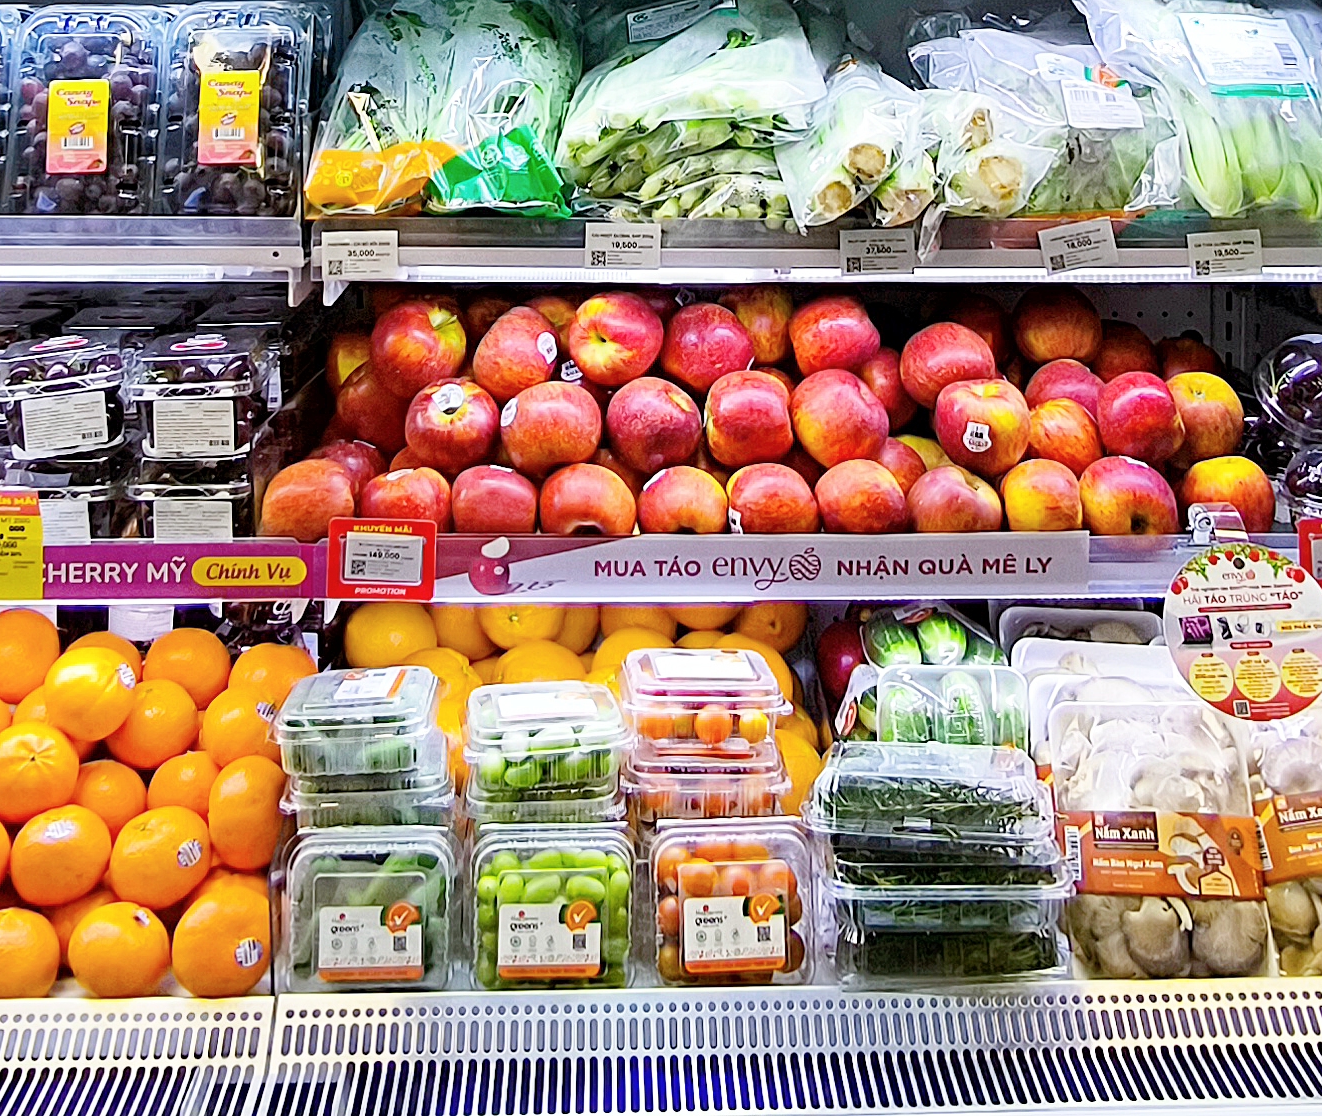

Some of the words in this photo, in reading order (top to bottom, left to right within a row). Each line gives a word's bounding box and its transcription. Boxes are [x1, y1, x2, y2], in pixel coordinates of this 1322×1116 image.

[207, 78, 246, 90] Candy
[56, 88, 95, 100] Candy
[353, 525, 392, 534] KHUYẾN
[393, 525, 413, 535] MÃI
[368, 550, 400, 561] 149,000
[43, 562, 140, 584] HERRY
[145, 555, 187, 584] MỸ
[205, 563, 262, 582] Chính
[264, 563, 292, 584] Vụ
[594, 559, 646, 577] MUA
[653, 554, 702, 577] TÁO
[711, 555, 787, 591] envy
[836, 555, 911, 580] NHẬN
[917, 553, 977, 576] QUÀ
[981, 552, 1018, 576] MÊ
[1023, 556, 1053, 575] LY
[353, 586, 407, 596] PROMOTION
[1204, 593, 1227, 604] TÁO
[1278, 810, 1307, 825] Nấm
[1095, 824, 1121, 841] Nấm
[1121, 827, 1155, 841] Xanh
[694, 914, 724, 927] greens
[330, 923, 360, 935] greens
[509, 920, 539, 934] greens
